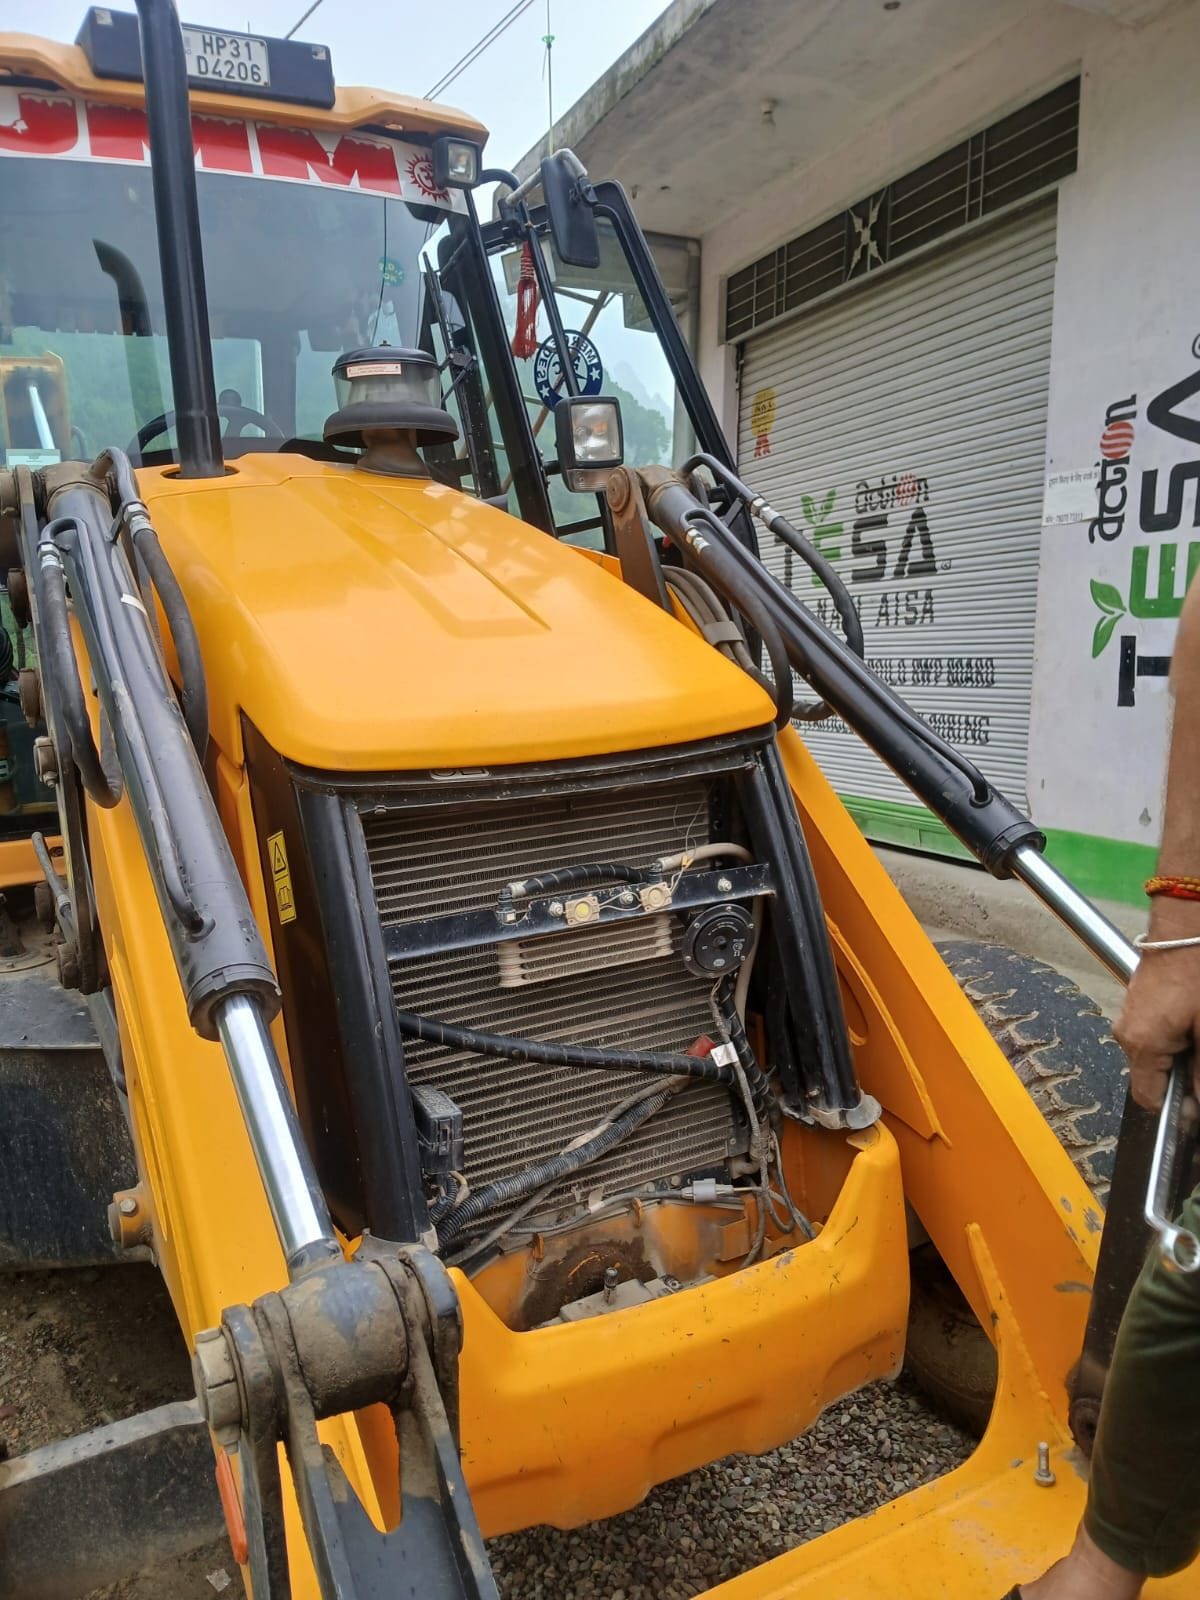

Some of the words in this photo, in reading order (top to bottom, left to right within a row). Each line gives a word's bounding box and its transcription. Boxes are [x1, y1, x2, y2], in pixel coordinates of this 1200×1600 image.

[202, 34, 252, 61] HP31
[197, 55, 262, 83] D4206
[774, 507, 938, 590] TESA
[875, 589, 935, 627] AISA
